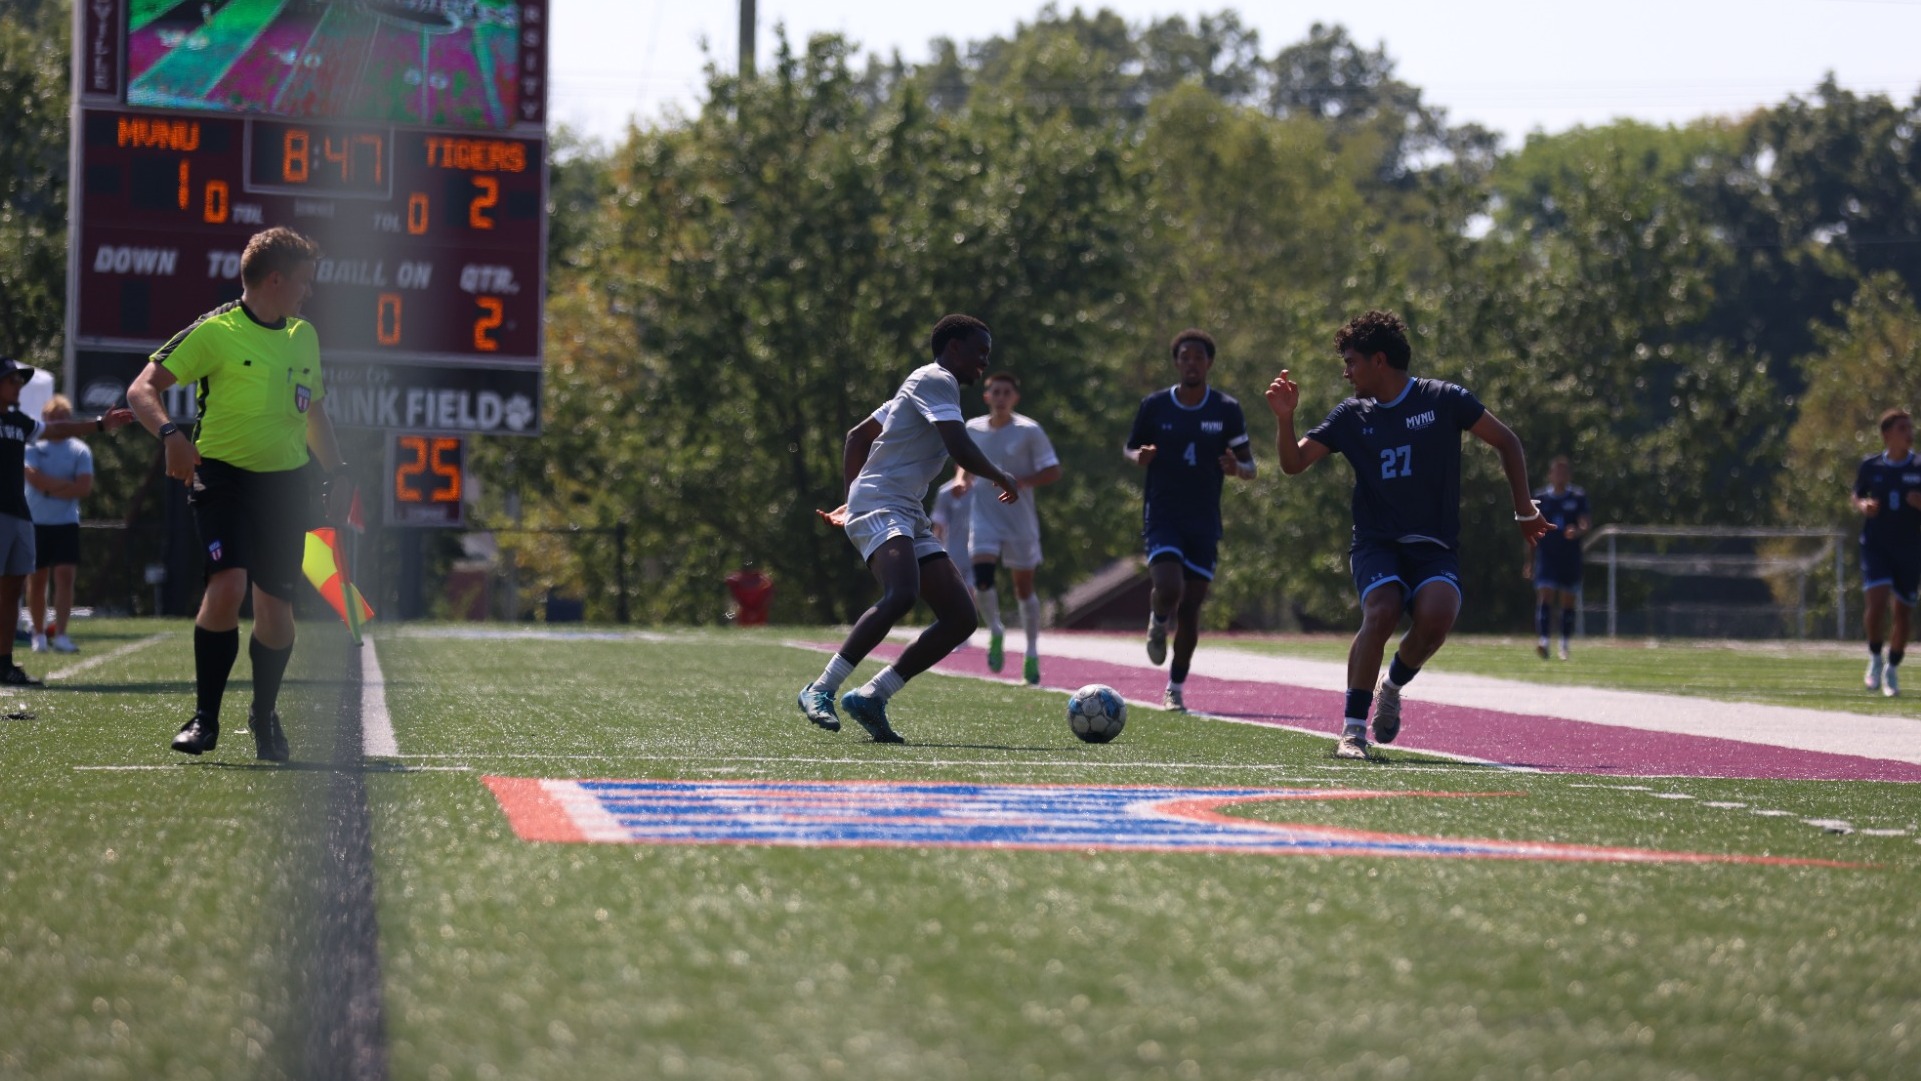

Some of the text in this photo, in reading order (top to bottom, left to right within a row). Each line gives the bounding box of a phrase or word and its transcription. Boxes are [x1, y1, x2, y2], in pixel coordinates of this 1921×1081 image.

[283, 129, 383, 186] 8:47
[424, 138, 526, 172] TIGERS
[178, 158, 190, 210] 1
[203, 180, 228, 224] 0
[469, 176, 499, 230] 2
[407, 194, 429, 235] 0
[94, 245, 178, 276] DOWN
[397, 262, 433, 290] ON
[377, 294, 401, 346] 0
[474, 297, 503, 351] 2
[405, 388, 502, 431] FIELD
[1405, 410, 1436, 429] MVNU
[396, 435, 461, 502] 25
[1183, 441, 1197, 467] 4
[1380, 444, 1412, 480] 27
